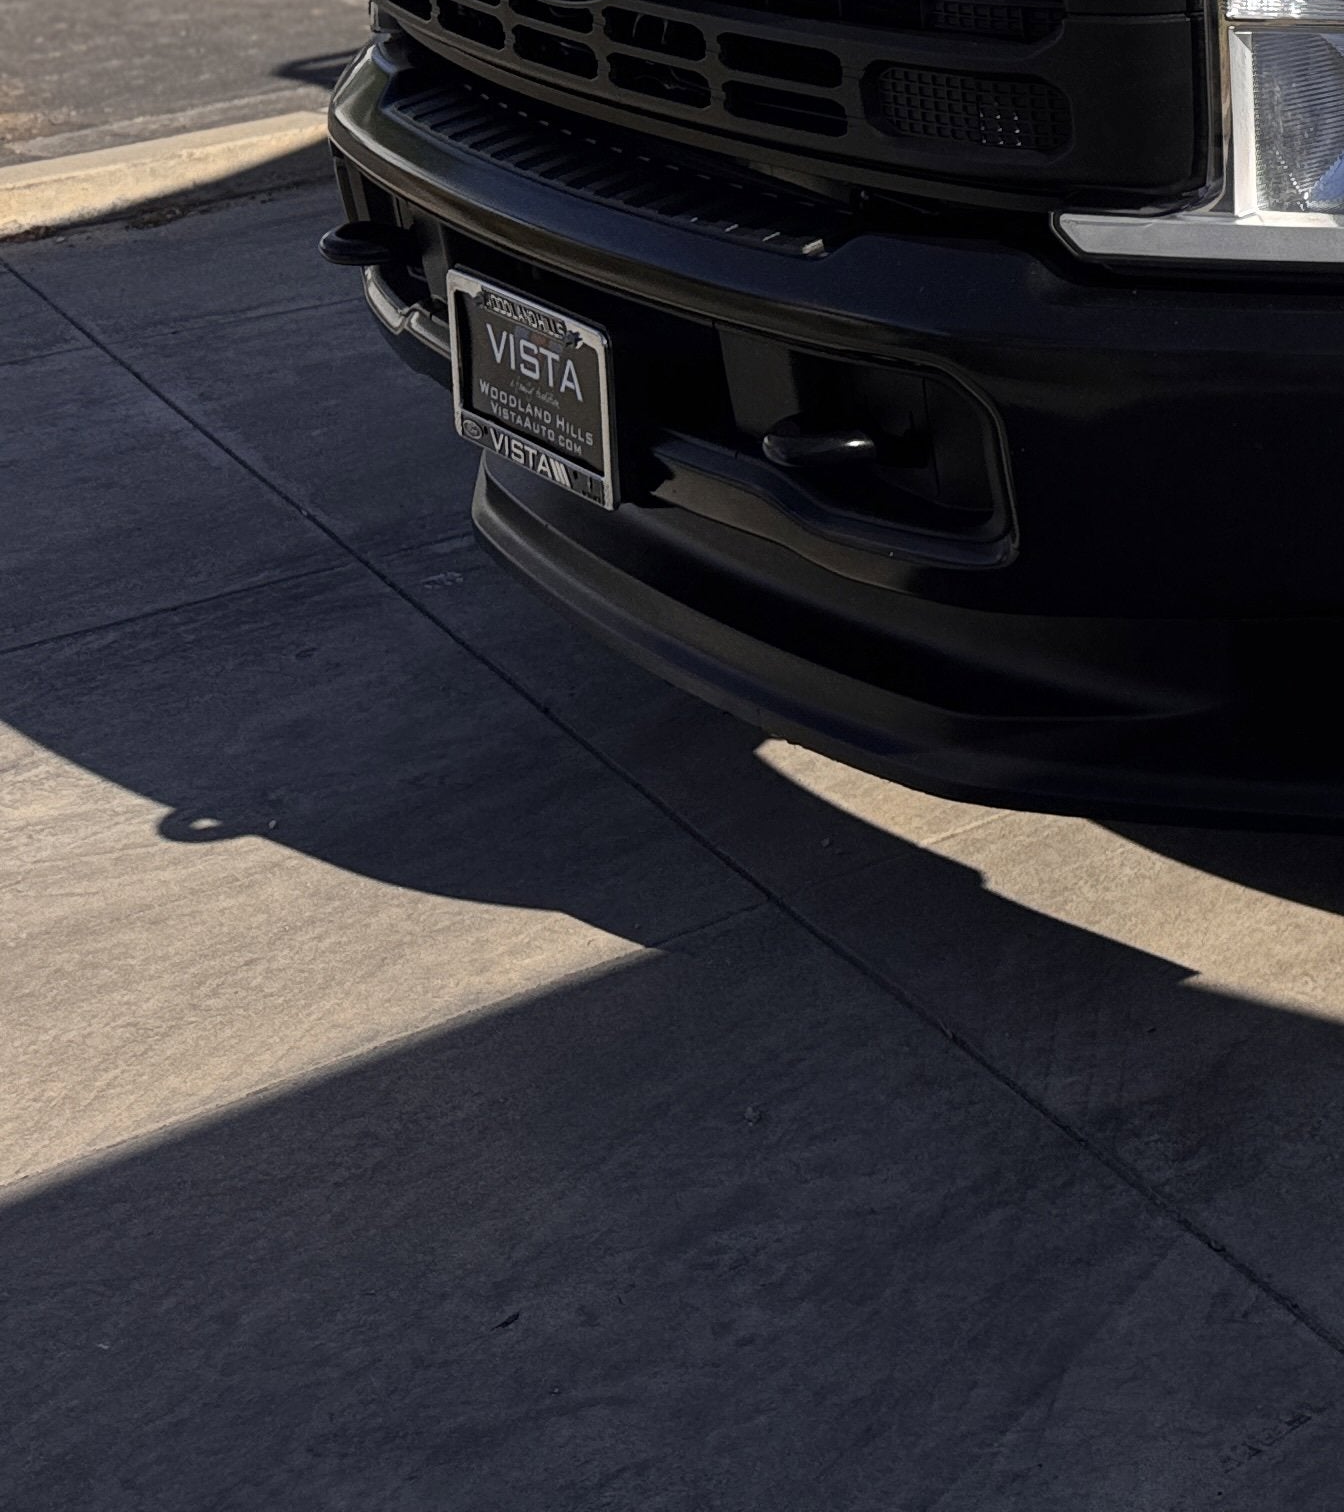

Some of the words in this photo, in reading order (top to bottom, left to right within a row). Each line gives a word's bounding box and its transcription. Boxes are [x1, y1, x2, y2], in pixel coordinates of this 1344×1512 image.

[486, 323, 584, 402] VISTA
[479, 378, 552, 425] WOODLAND
[555, 413, 594, 446] HILLS
[489, 427, 554, 481] VISTA
